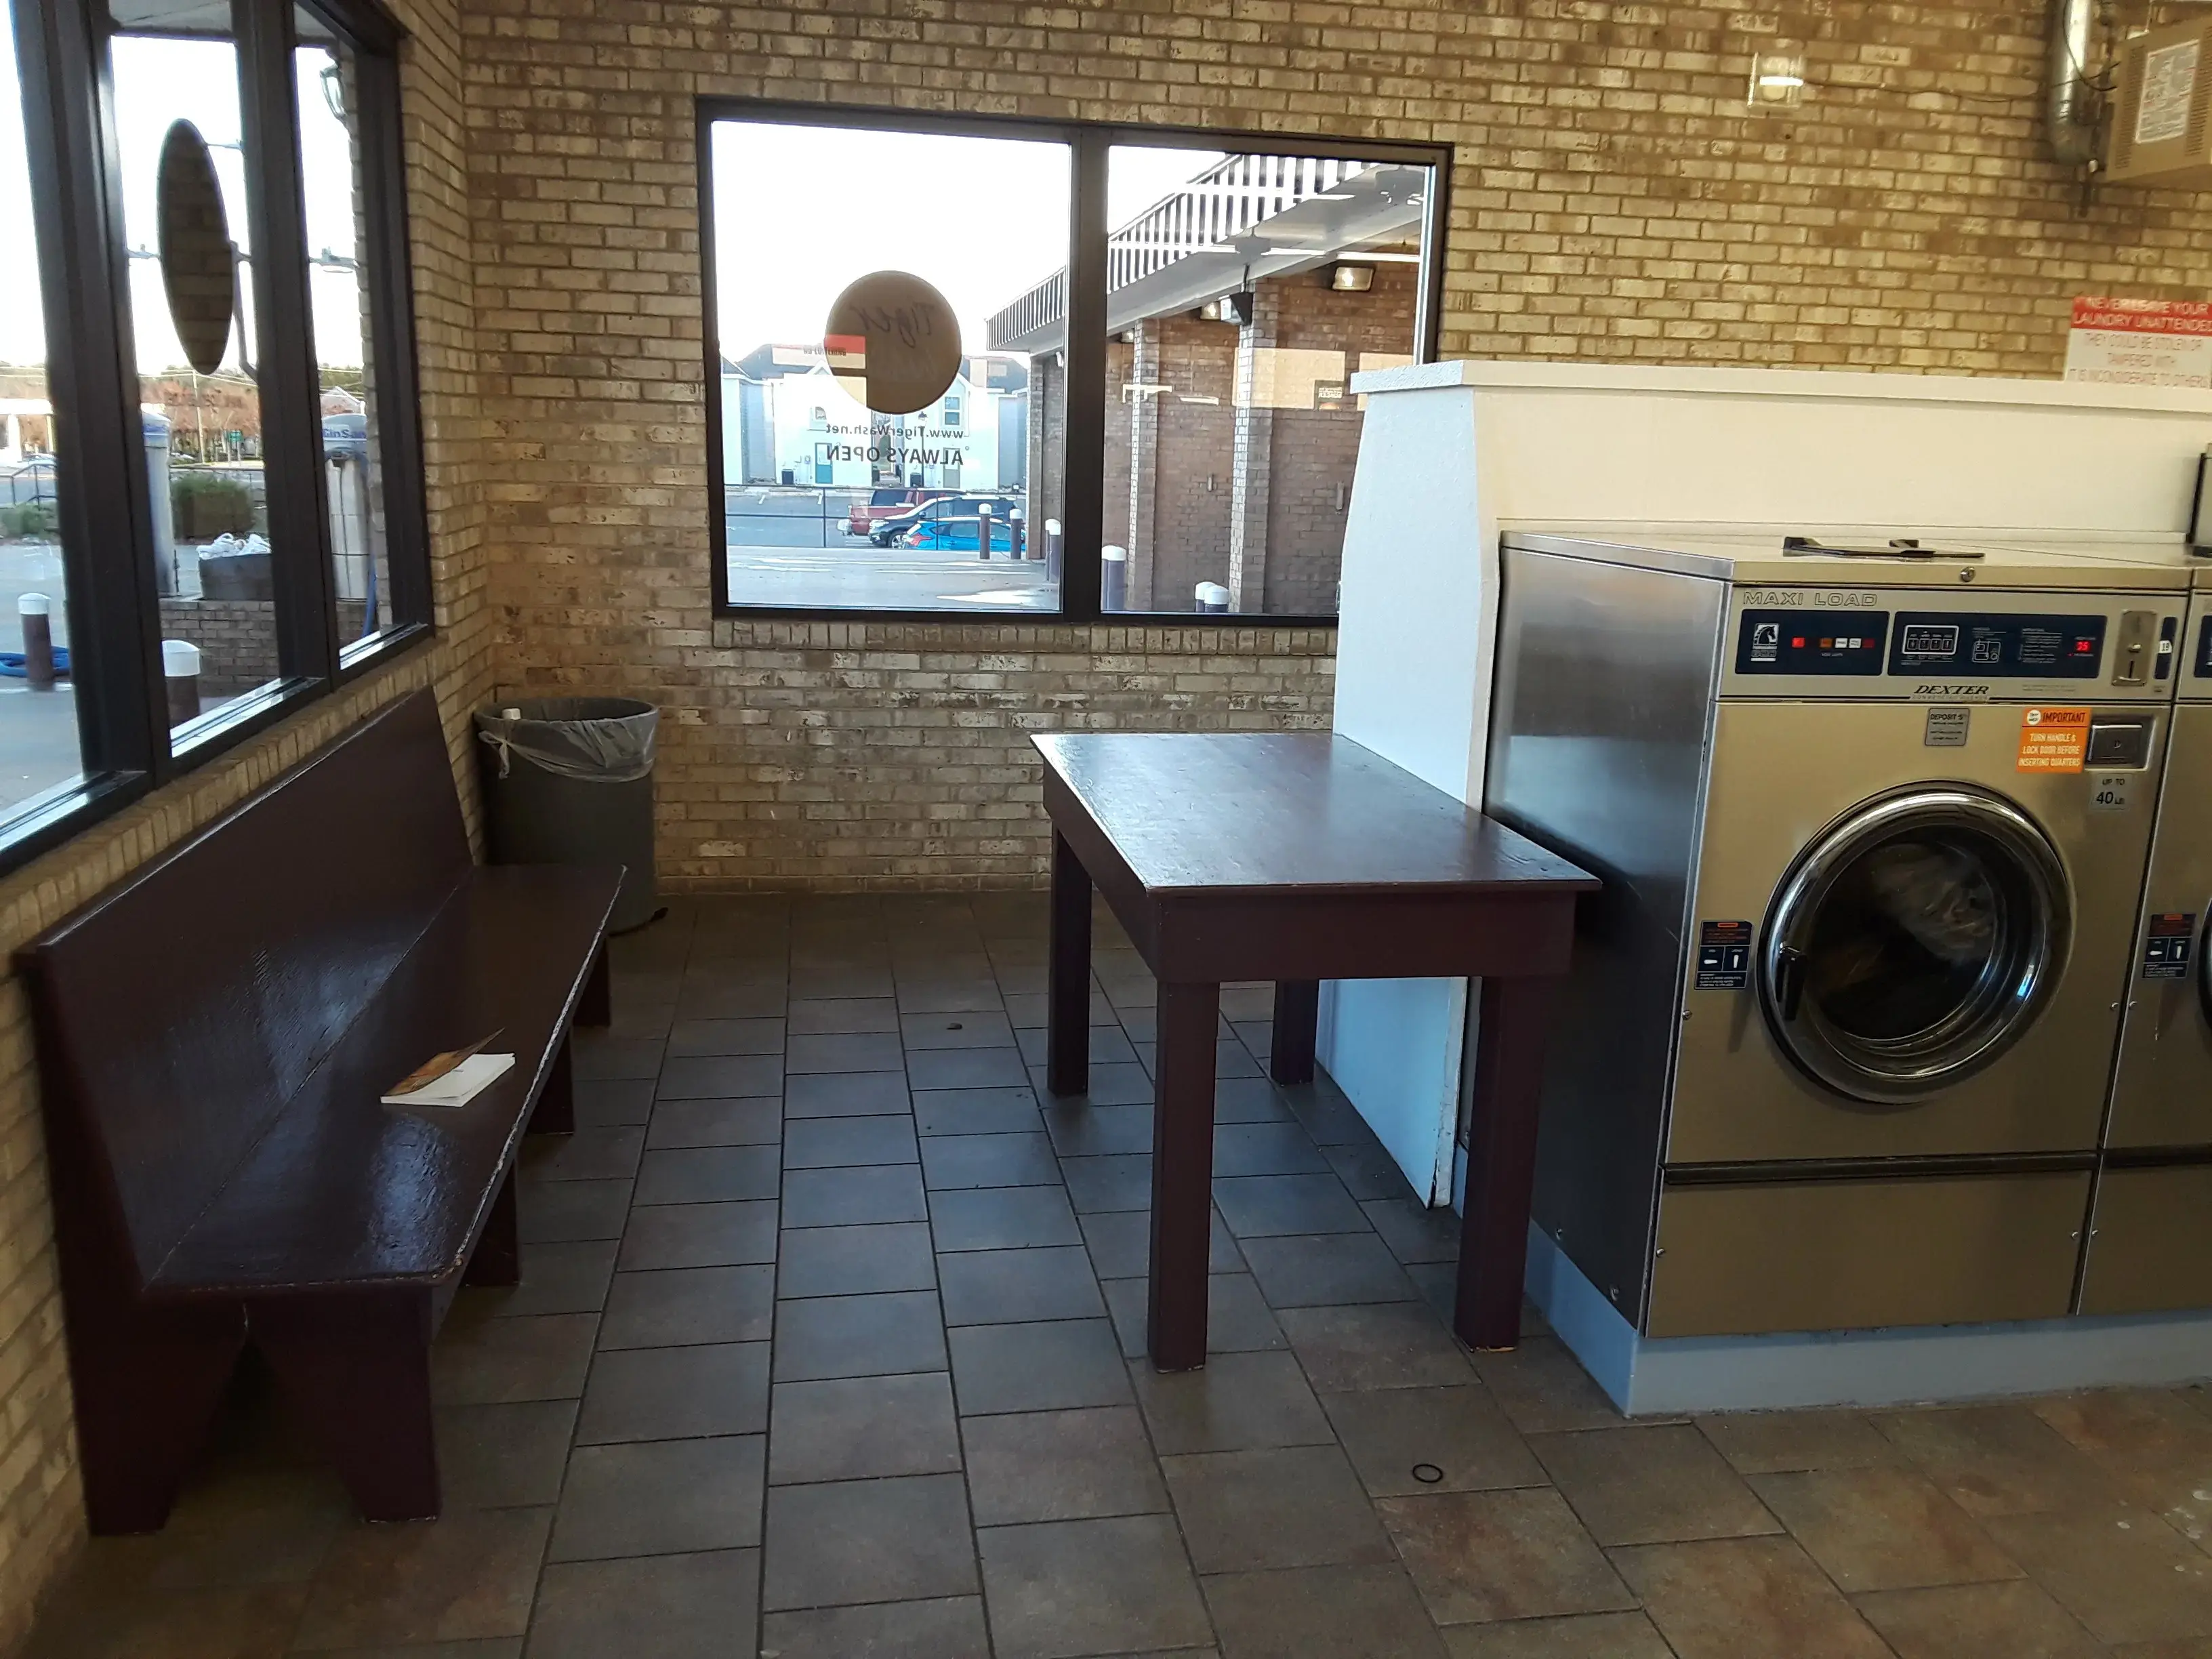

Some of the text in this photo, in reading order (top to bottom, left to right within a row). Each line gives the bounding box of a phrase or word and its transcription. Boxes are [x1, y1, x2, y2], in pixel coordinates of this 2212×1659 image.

[2172, 302, 2209, 315] YOUR
[2073, 312, 2133, 326] LAUNDRY
[1743, 592, 1878, 607] MAXI LOAD
[1914, 685, 1990, 695] DEXTER
[2042, 712, 2085, 722] IMPORTANT
[2030, 733, 2046, 742] TURN
[2047, 734, 2071, 742] HANDLE
[2022, 745, 2081, 754] LOCK DOOR BEFORE
[2018, 758, 2081, 766] INSERTING QUARTERS
[2096, 792, 2114, 804] 40
